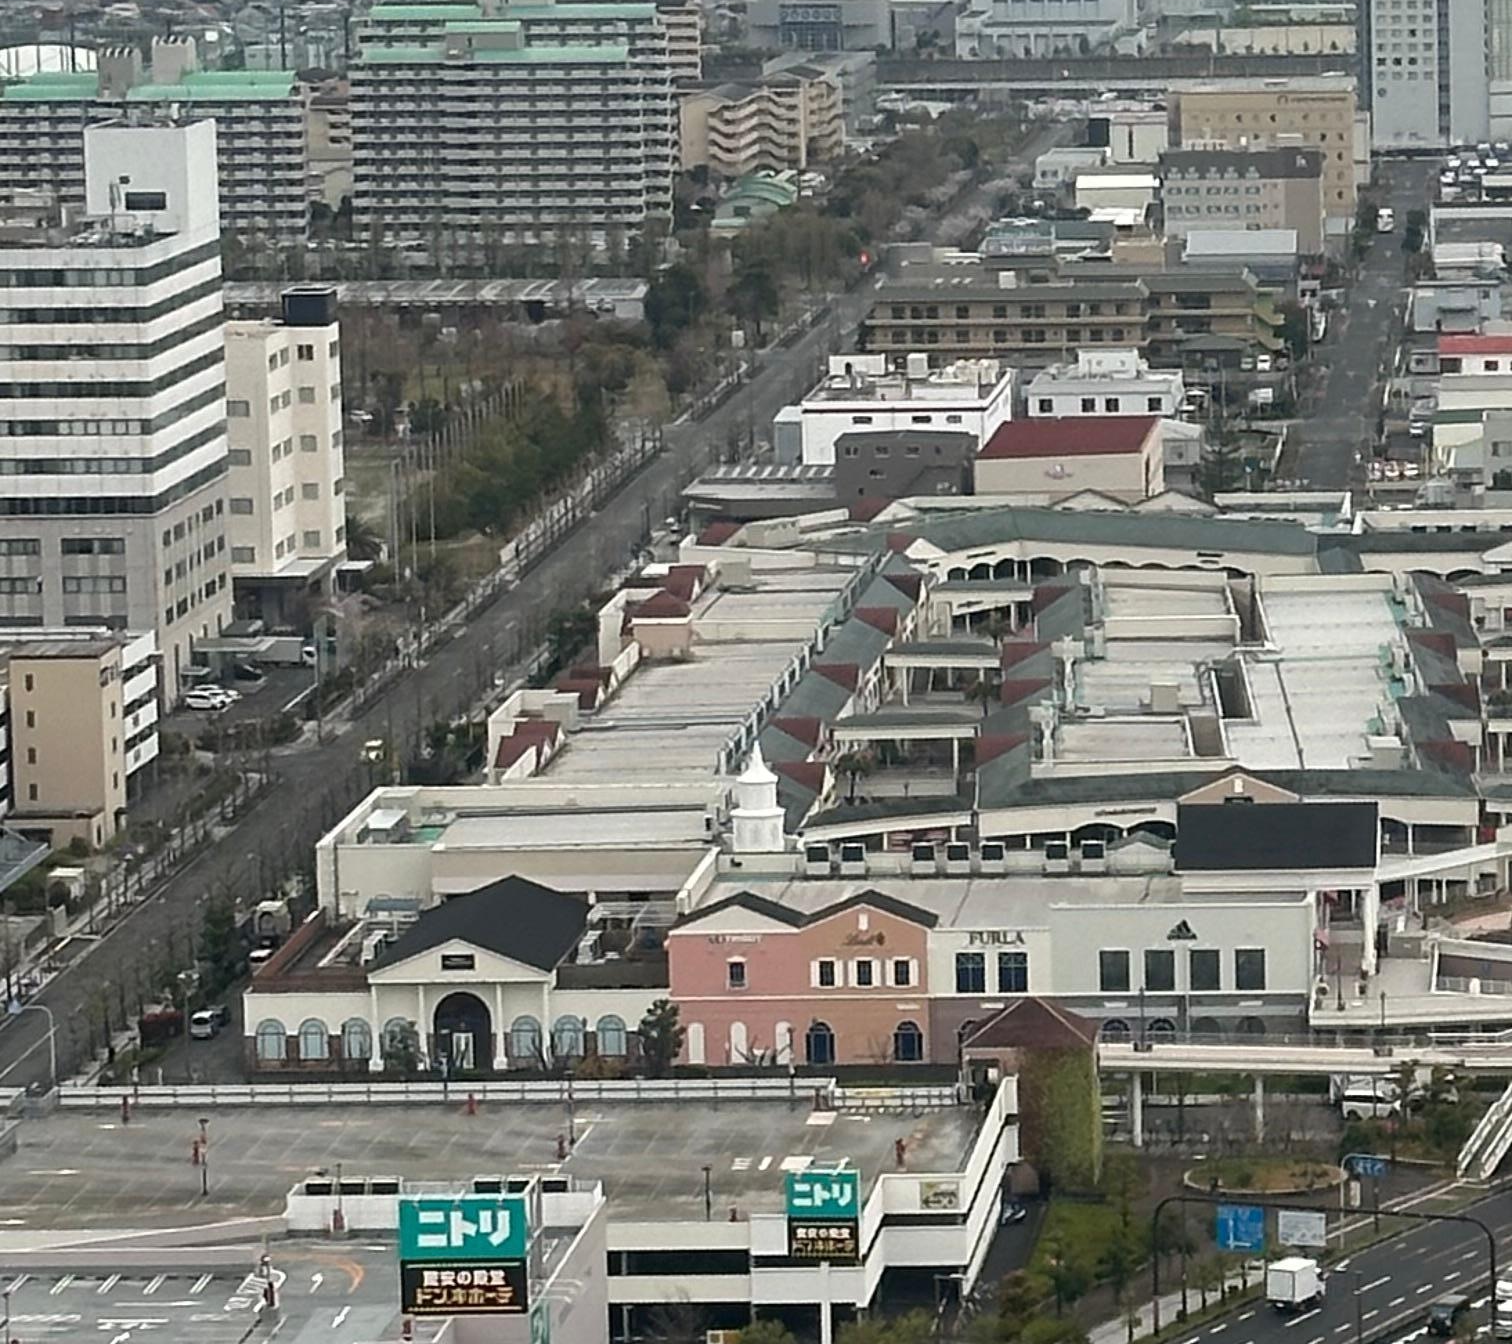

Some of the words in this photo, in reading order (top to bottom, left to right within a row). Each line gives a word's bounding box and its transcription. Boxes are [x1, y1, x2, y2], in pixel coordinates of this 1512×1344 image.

[968, 930, 1026, 946] FURLA
[793, 1183, 852, 1207] ニトリ
[417, 1209, 510, 1247] ニトリ
